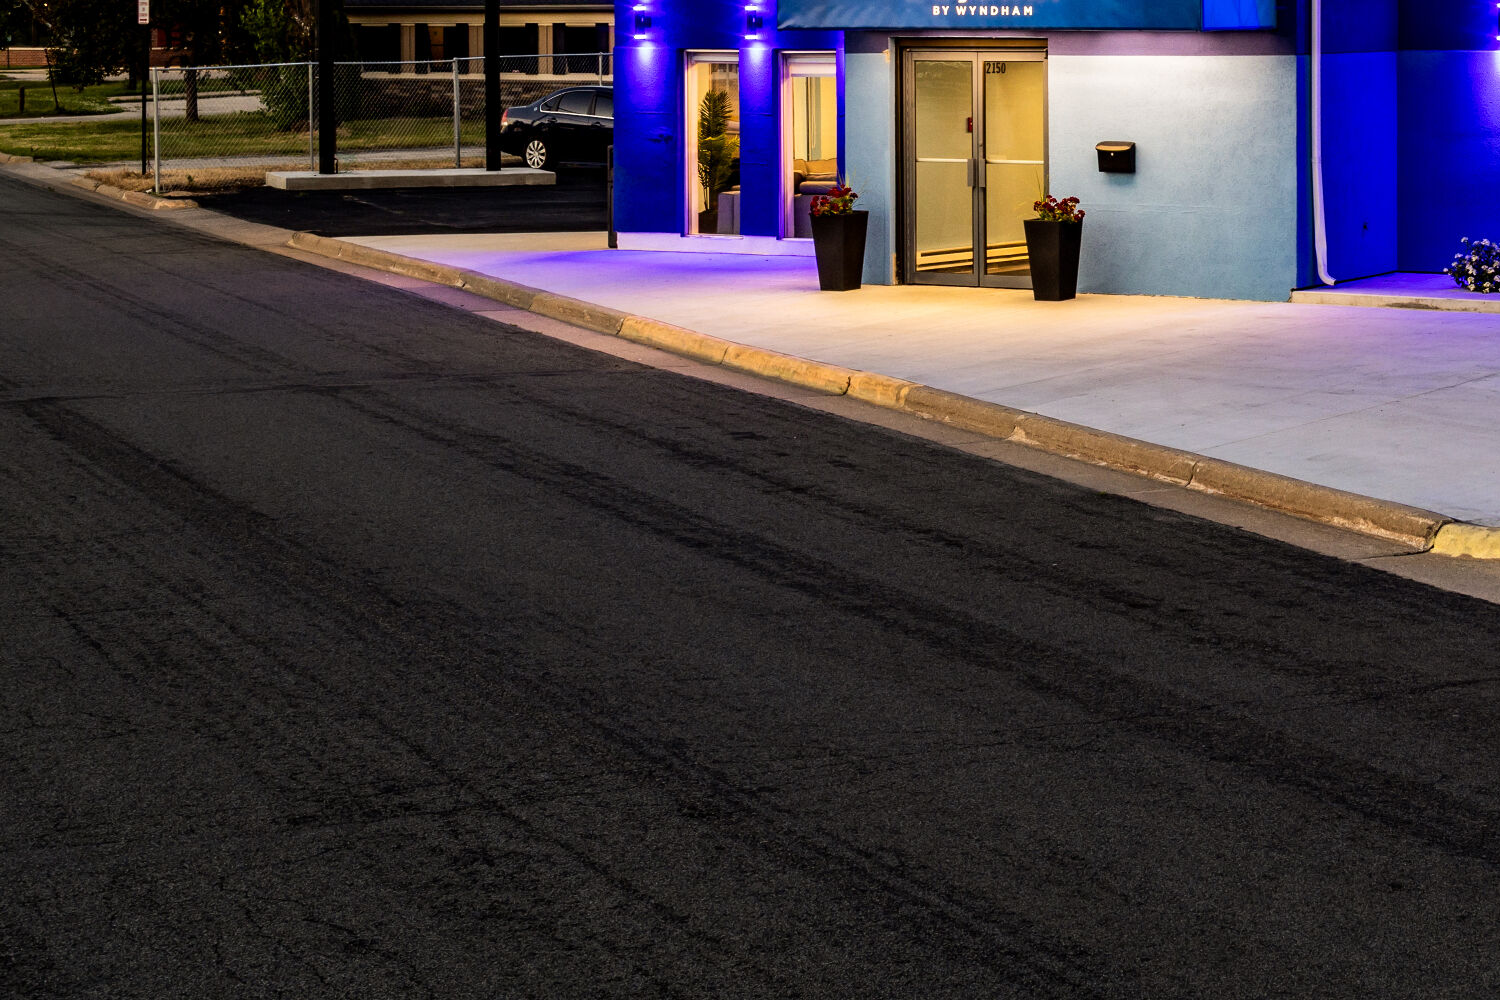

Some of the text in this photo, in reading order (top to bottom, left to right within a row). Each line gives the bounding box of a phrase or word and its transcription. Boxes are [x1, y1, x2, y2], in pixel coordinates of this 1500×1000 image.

[932, 5, 1033, 16] BY WYNDHAM
[986, 62, 1006, 74] 2150
